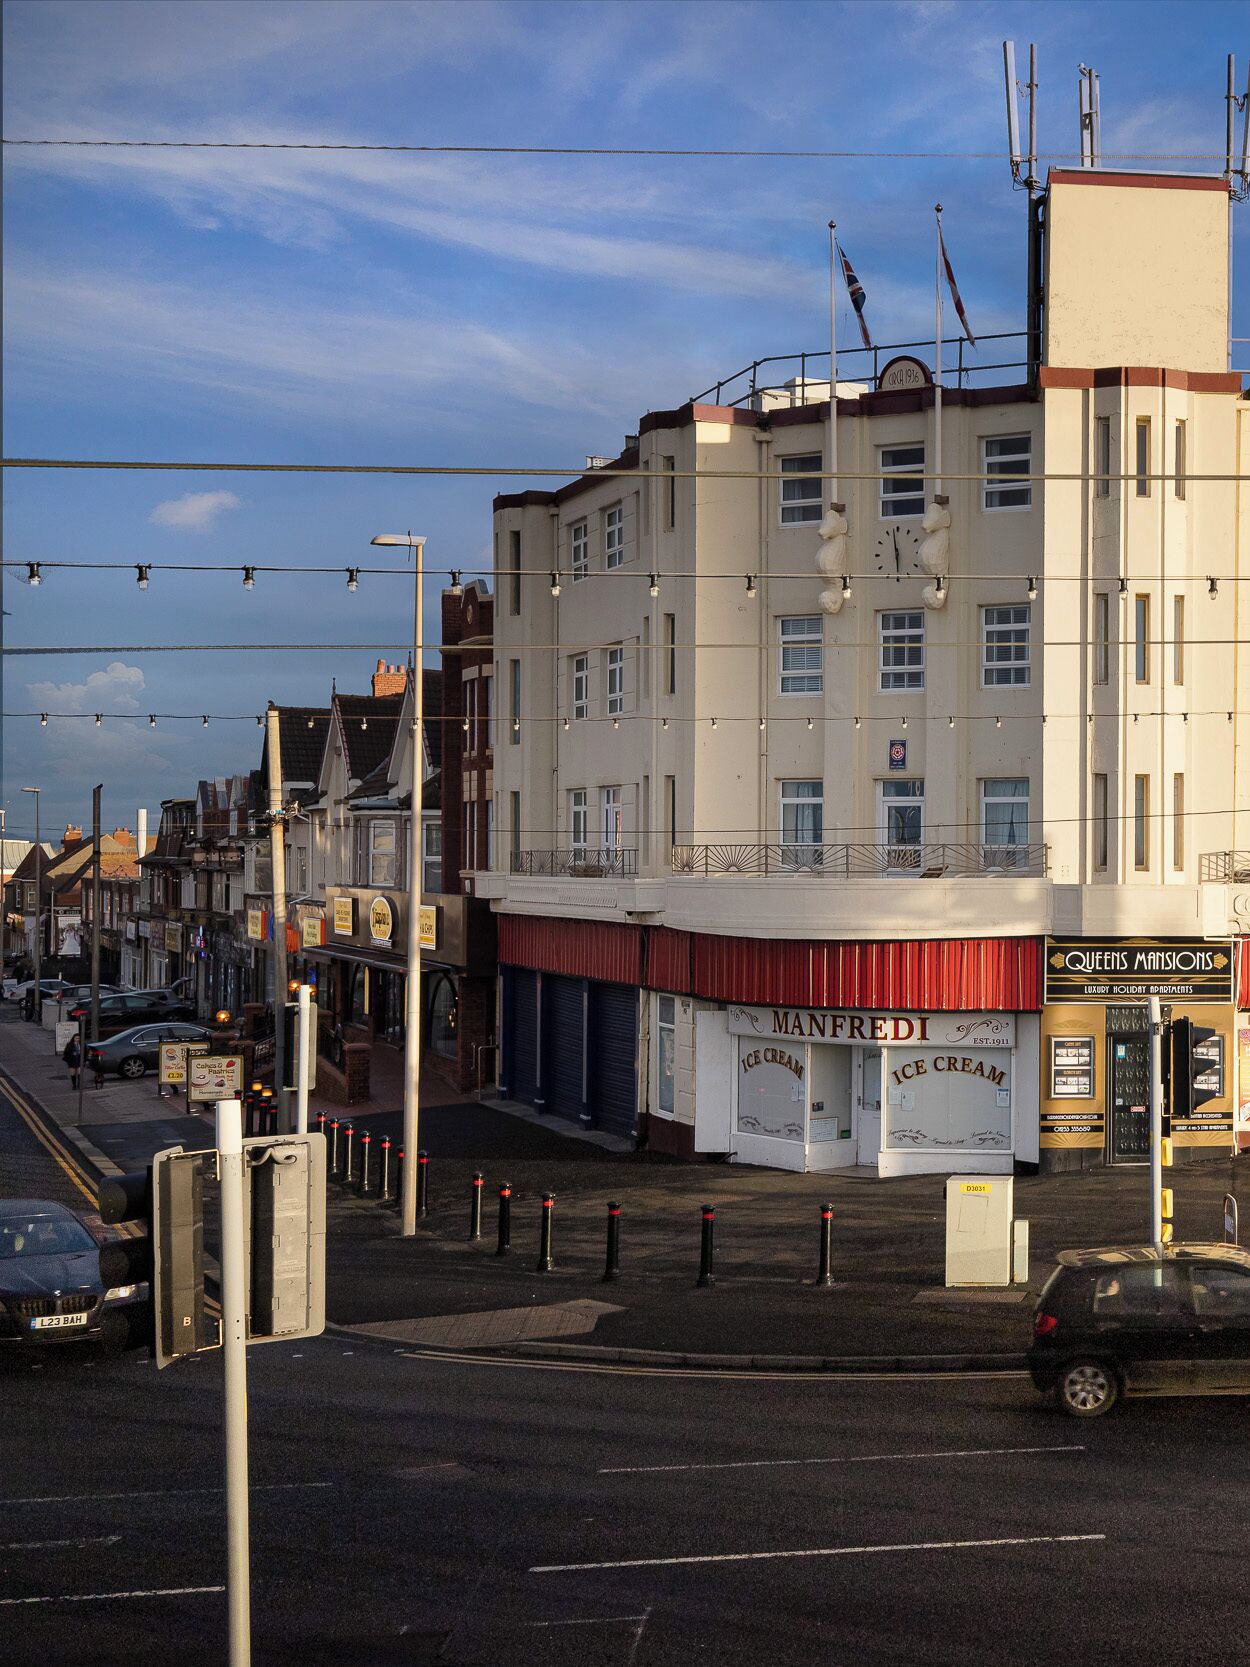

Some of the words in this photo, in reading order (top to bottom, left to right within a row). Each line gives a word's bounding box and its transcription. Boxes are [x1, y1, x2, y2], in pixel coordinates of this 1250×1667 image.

[905, 368, 920, 384] 1936
[1065, 951, 1129, 973] QUEENS
[1133, 951, 1213, 971] MANSIONS
[1084, 985, 1110, 994] LUXURY
[1113, 985, 1146, 994] HOLIDAY
[1149, 985, 1193, 994] APARTMENTS
[771, 1009, 931, 1041] MANFREDI
[973, 1037, 1010, 1045] EST.1911
[741, 1049, 762, 1074] ICE
[763, 1047, 805, 1081] CREAM
[891, 1058, 928, 1086] ICE
[933, 1055, 1007, 1087] CREAM
[40, 1317, 61, 1327] L23
[62, 1315, 82, 1325] BAH
[183, 1316, 192, 1327] B
